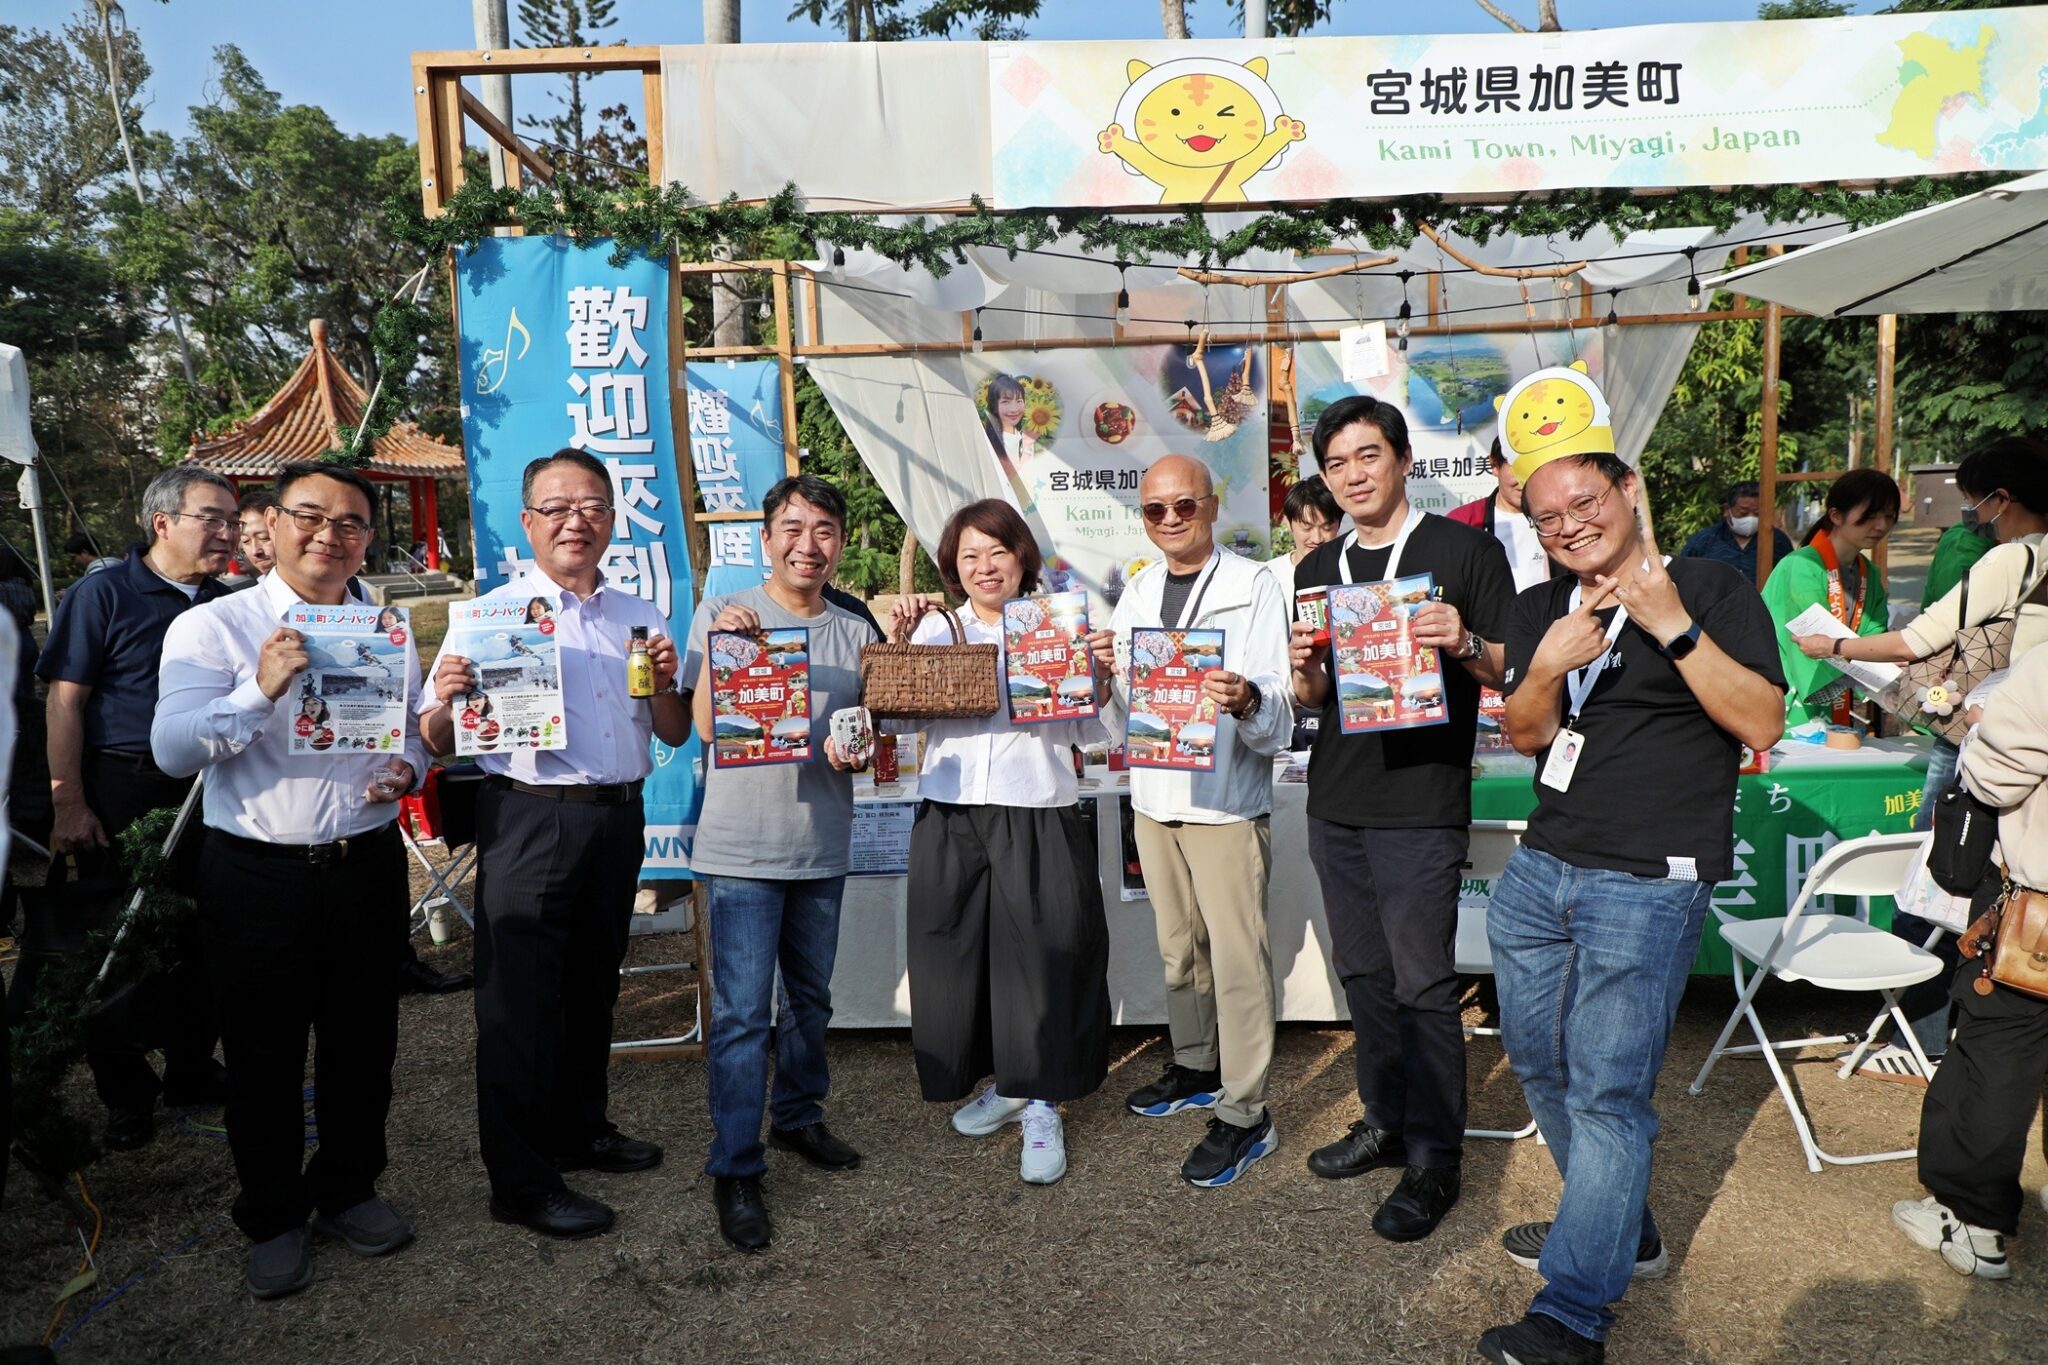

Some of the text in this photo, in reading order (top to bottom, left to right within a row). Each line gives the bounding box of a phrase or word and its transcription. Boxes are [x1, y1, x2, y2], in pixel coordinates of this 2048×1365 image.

[1366, 60, 1683, 115] 宮城県加美町
[1378, 126, 1801, 161] Kami Town, Miyagi, Japan
[1049, 468, 1148, 491] 宮城県加
[1066, 505, 1112, 521] Kami
[1026, 647, 1068, 666] 加美町
[1361, 641, 1414, 662] 加美町
[737, 686, 786, 705] 加美町
[1152, 687, 1198, 705] 加美町
